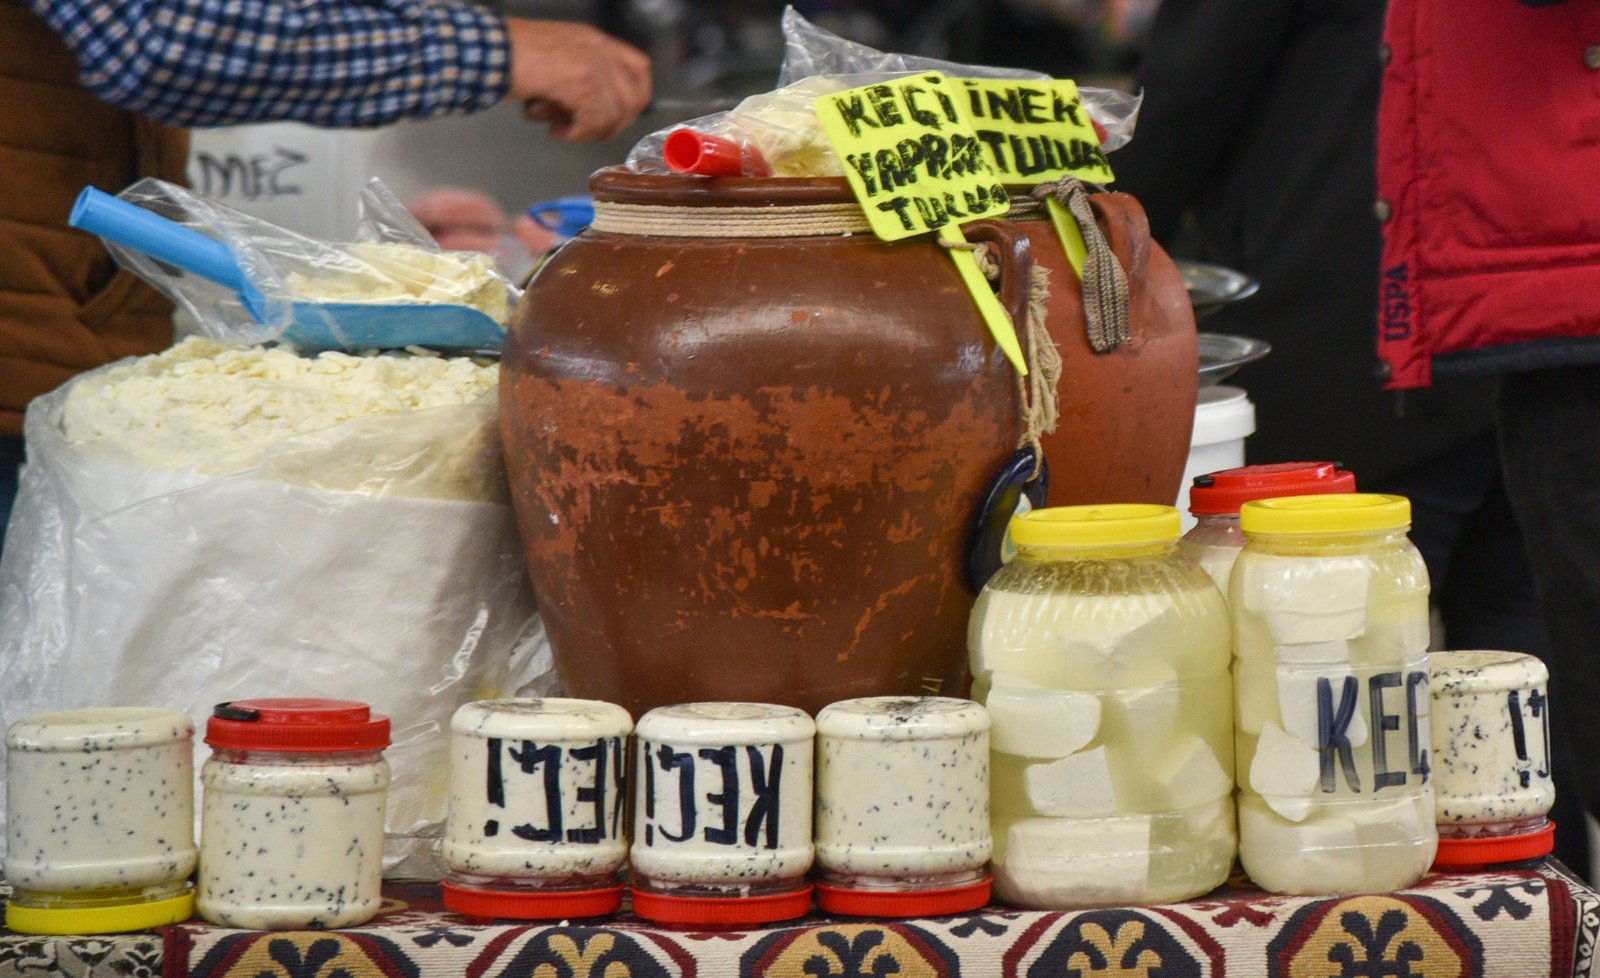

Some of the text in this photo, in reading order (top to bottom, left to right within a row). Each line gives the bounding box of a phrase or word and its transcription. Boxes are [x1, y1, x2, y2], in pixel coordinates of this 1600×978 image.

[832, 75, 960, 138] KEÇİ
[963, 80, 1084, 127] İNEK
[194, 146, 308, 201] MEZ
[1385, 262, 1410, 341] USPA
[1317, 671, 1431, 793] KEÇ
[645, 742, 784, 849] KEÇİ
